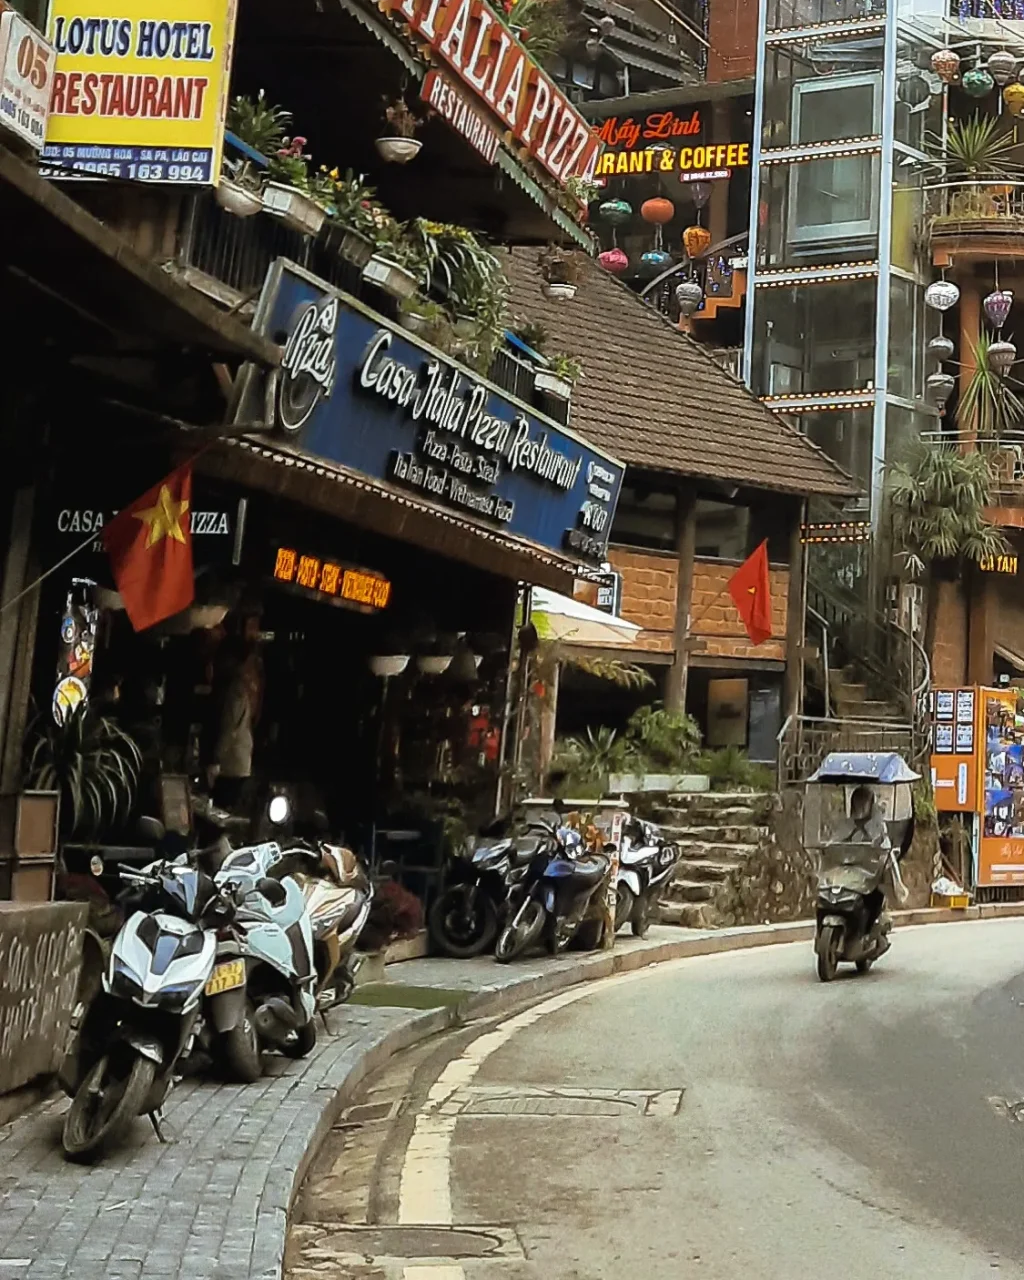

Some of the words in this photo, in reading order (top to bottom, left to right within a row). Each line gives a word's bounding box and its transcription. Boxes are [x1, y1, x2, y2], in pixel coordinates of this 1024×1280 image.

[17, 35, 50, 90] 05
[55, 17, 132, 56] LOTUS
[136, 21, 214, 59] HOTEL
[51, 72, 208, 120] RESTAURANT
[430, 74, 501, 166] RESTAURANT
[524, 76, 600, 186] PIZZA
[643, 110, 701, 139] Linh
[62, 147, 75, 158] 05
[127, 163, 163, 181] 163
[168, 164, 204, 181] 994
[660, 149, 675, 171] &
[680, 143, 749, 170] COFFEE
[281, 305, 335, 397] Pizza
[361, 328, 416, 407] Casa
[413, 361, 464, 432] Italia
[461, 384, 510, 454] Pizza
[508, 416, 583, 490] Restaurant
[422, 430, 448, 462] Pizza
[450, 444, 473, 474] Pasta
[476, 455, 501, 485] Steak
[393, 451, 423, 486] Italian
[423, 466, 448, 495] Food
[450, 475, 494, 515] Vietnamese
[494, 497, 516, 522] Food
[57, 509, 104, 533] CASA
[189, 511, 229, 534] IZZA
